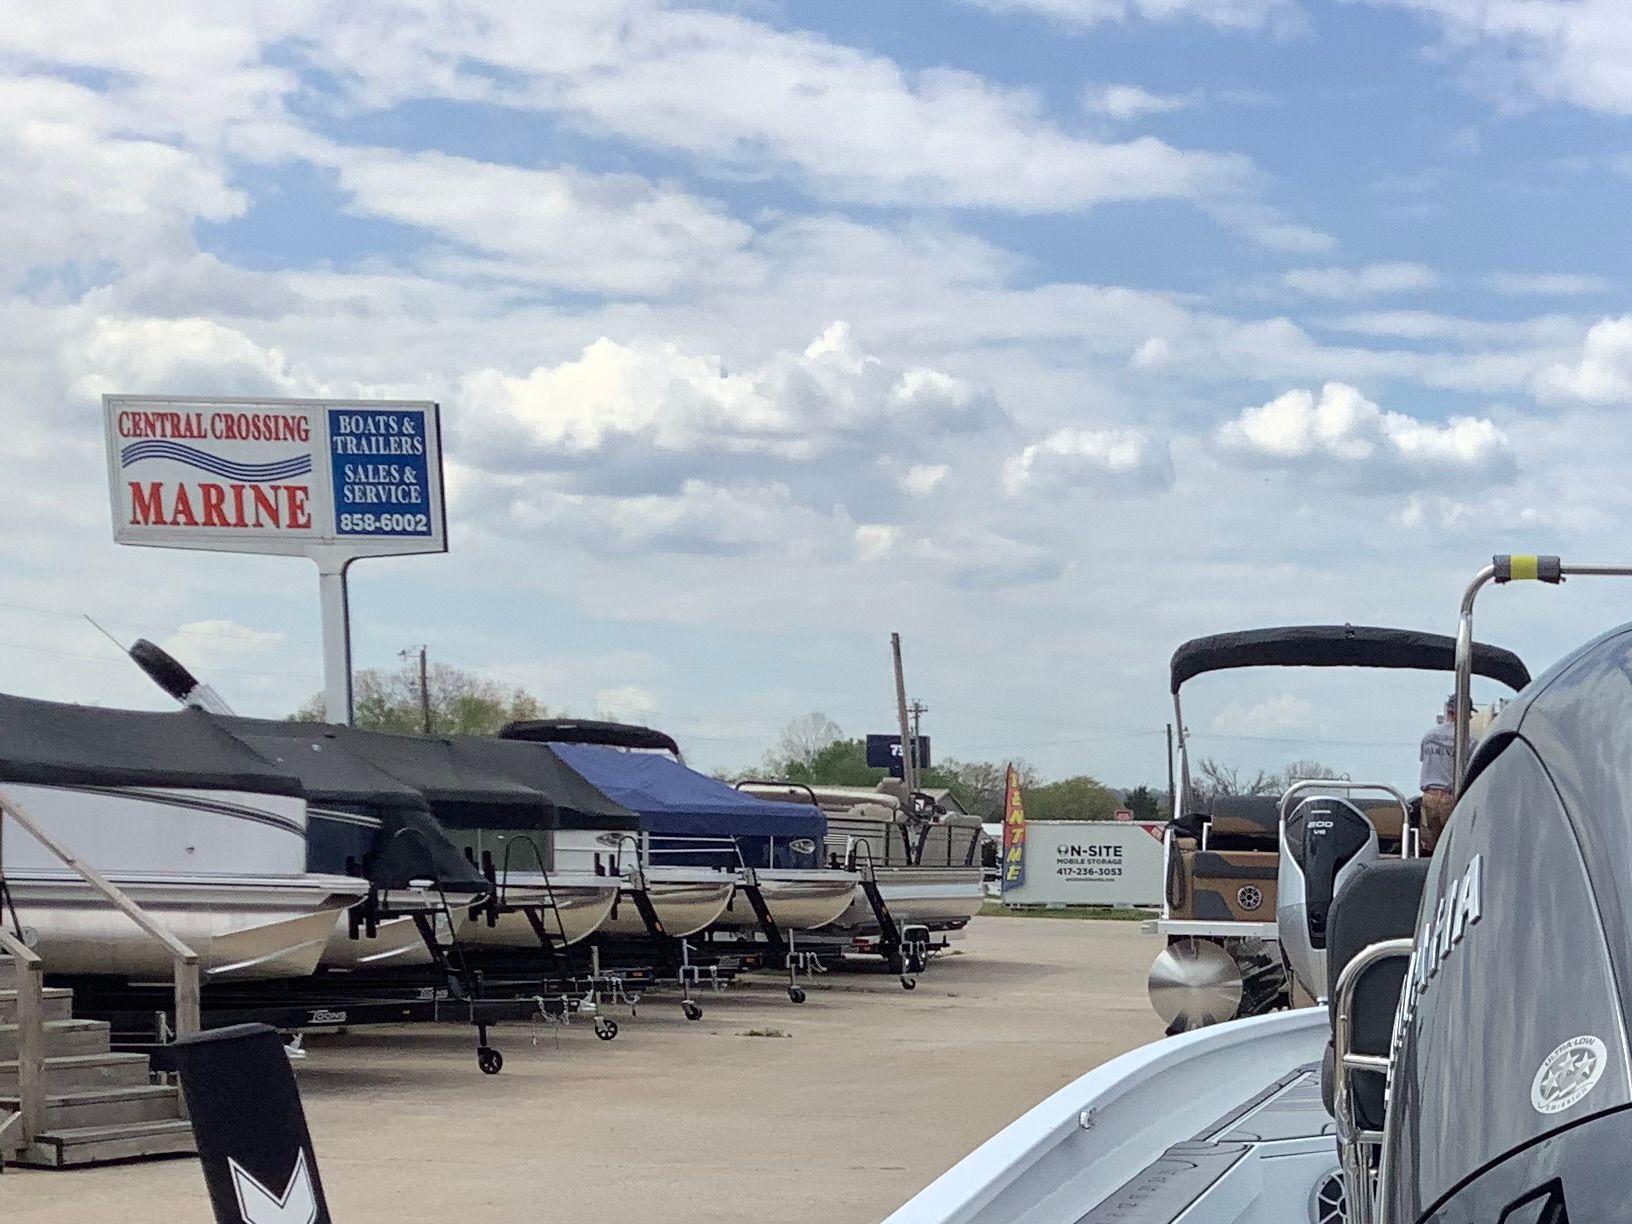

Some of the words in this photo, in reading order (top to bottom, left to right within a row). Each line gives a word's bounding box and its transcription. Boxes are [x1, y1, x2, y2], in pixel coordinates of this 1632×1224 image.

[118, 411, 207, 439] CENTRAL
[210, 413, 311, 442] CROSSING
[339, 415, 398, 434] BOATS
[402, 417, 415, 434] &
[333, 436, 423, 455] TRAILERS
[344, 464, 400, 483] SALES
[403, 466, 417, 483] &
[343, 485, 421, 504] SERVICE
[128, 481, 311, 529] MARINE
[340, 513, 427, 531] 858-6002
[1057, 844, 1122, 857] ON-SITE
